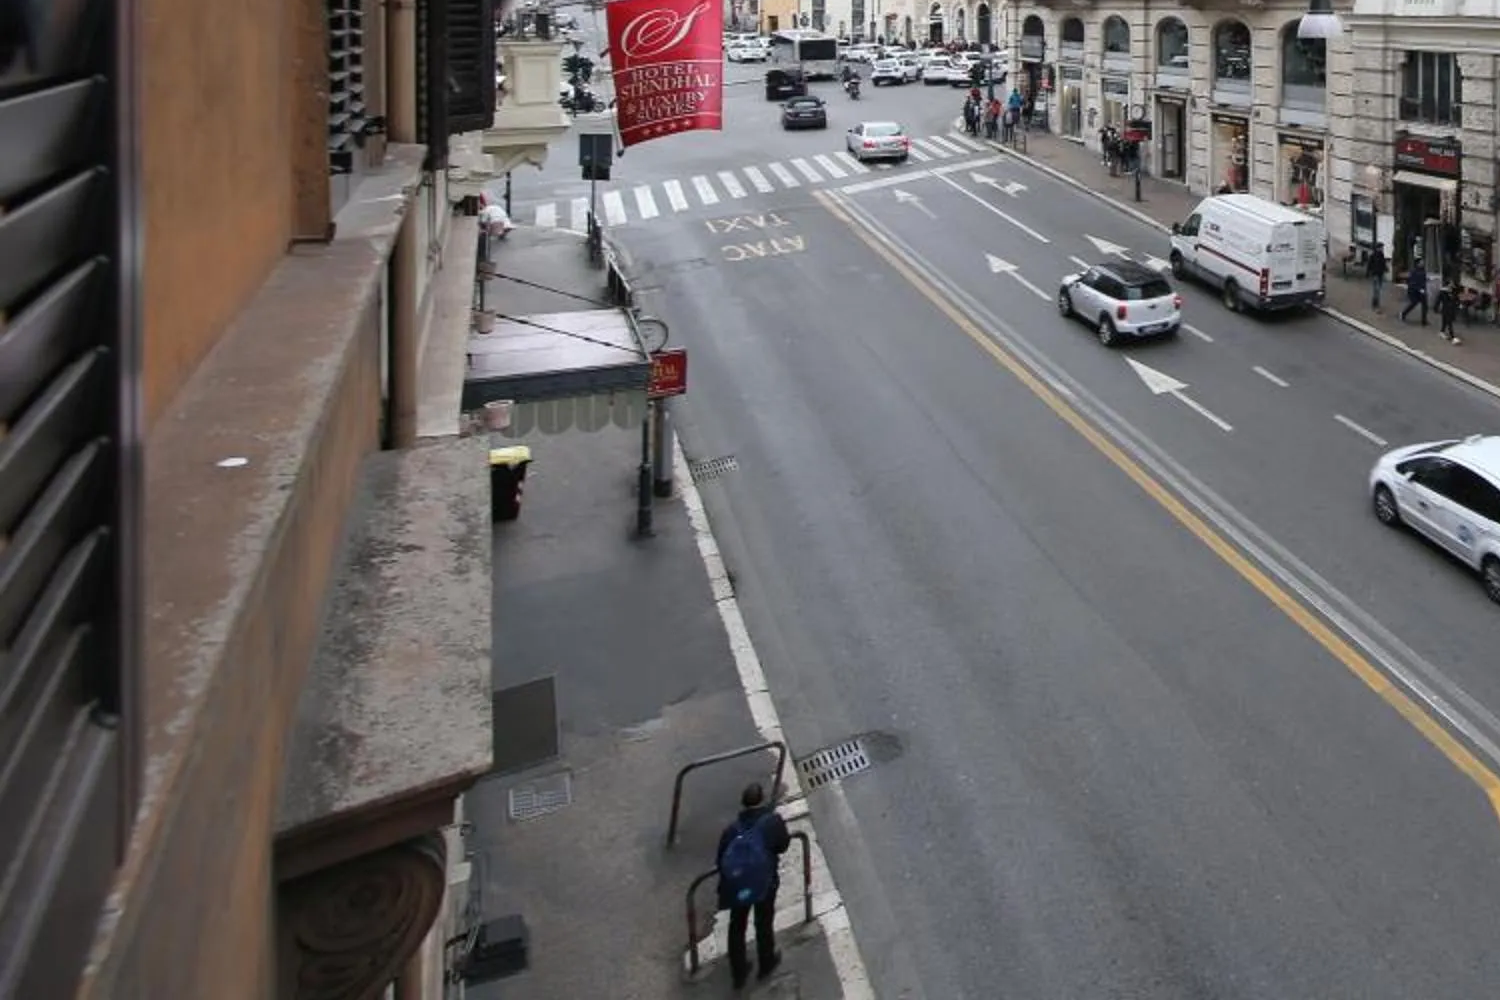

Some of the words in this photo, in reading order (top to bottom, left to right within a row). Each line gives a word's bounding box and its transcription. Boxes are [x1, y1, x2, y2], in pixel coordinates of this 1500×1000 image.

[631, 63, 699, 82] HOTEL
[620, 73, 716, 100] STENDHAL
[636, 101, 697, 122] SUITES
[638, 90, 706, 112] LUXURY
[705, 211, 791, 234] TAXI
